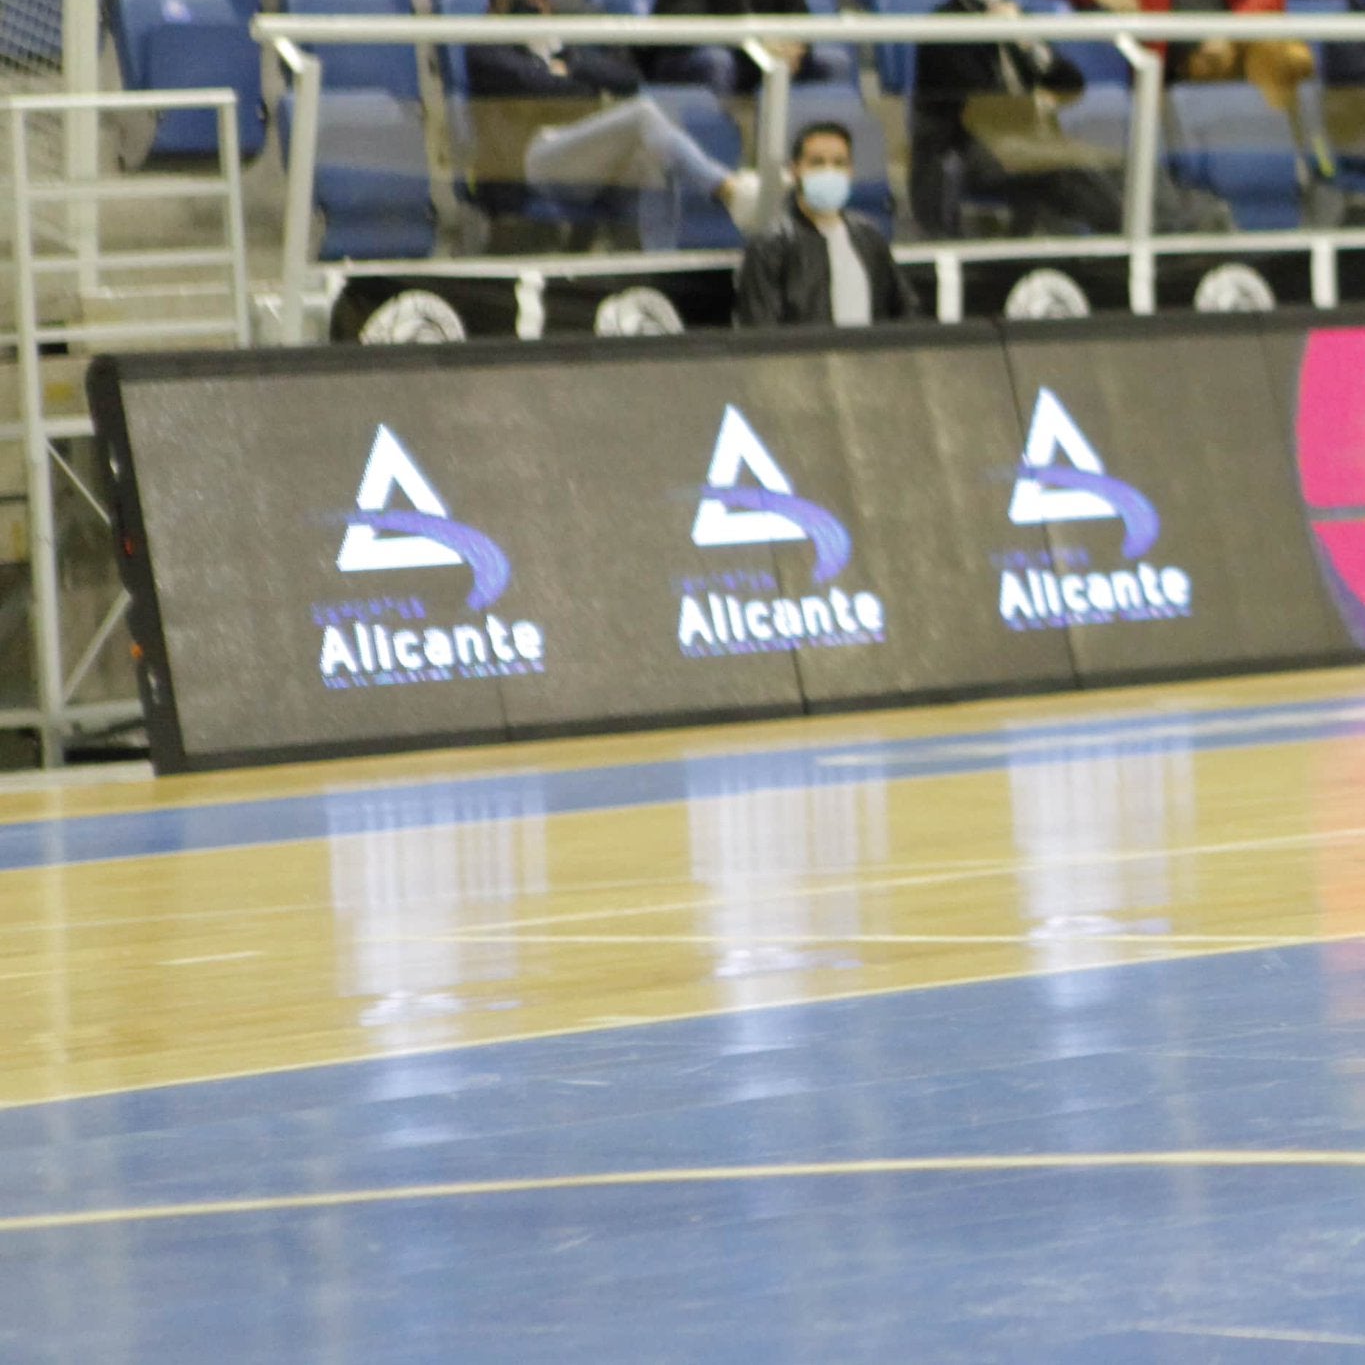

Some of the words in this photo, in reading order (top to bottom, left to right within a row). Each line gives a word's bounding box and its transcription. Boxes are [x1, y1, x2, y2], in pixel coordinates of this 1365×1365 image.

[679, 586, 884, 646] Alicante
[999, 562, 1192, 620] Alicante
[319, 613, 545, 677] Alicante
